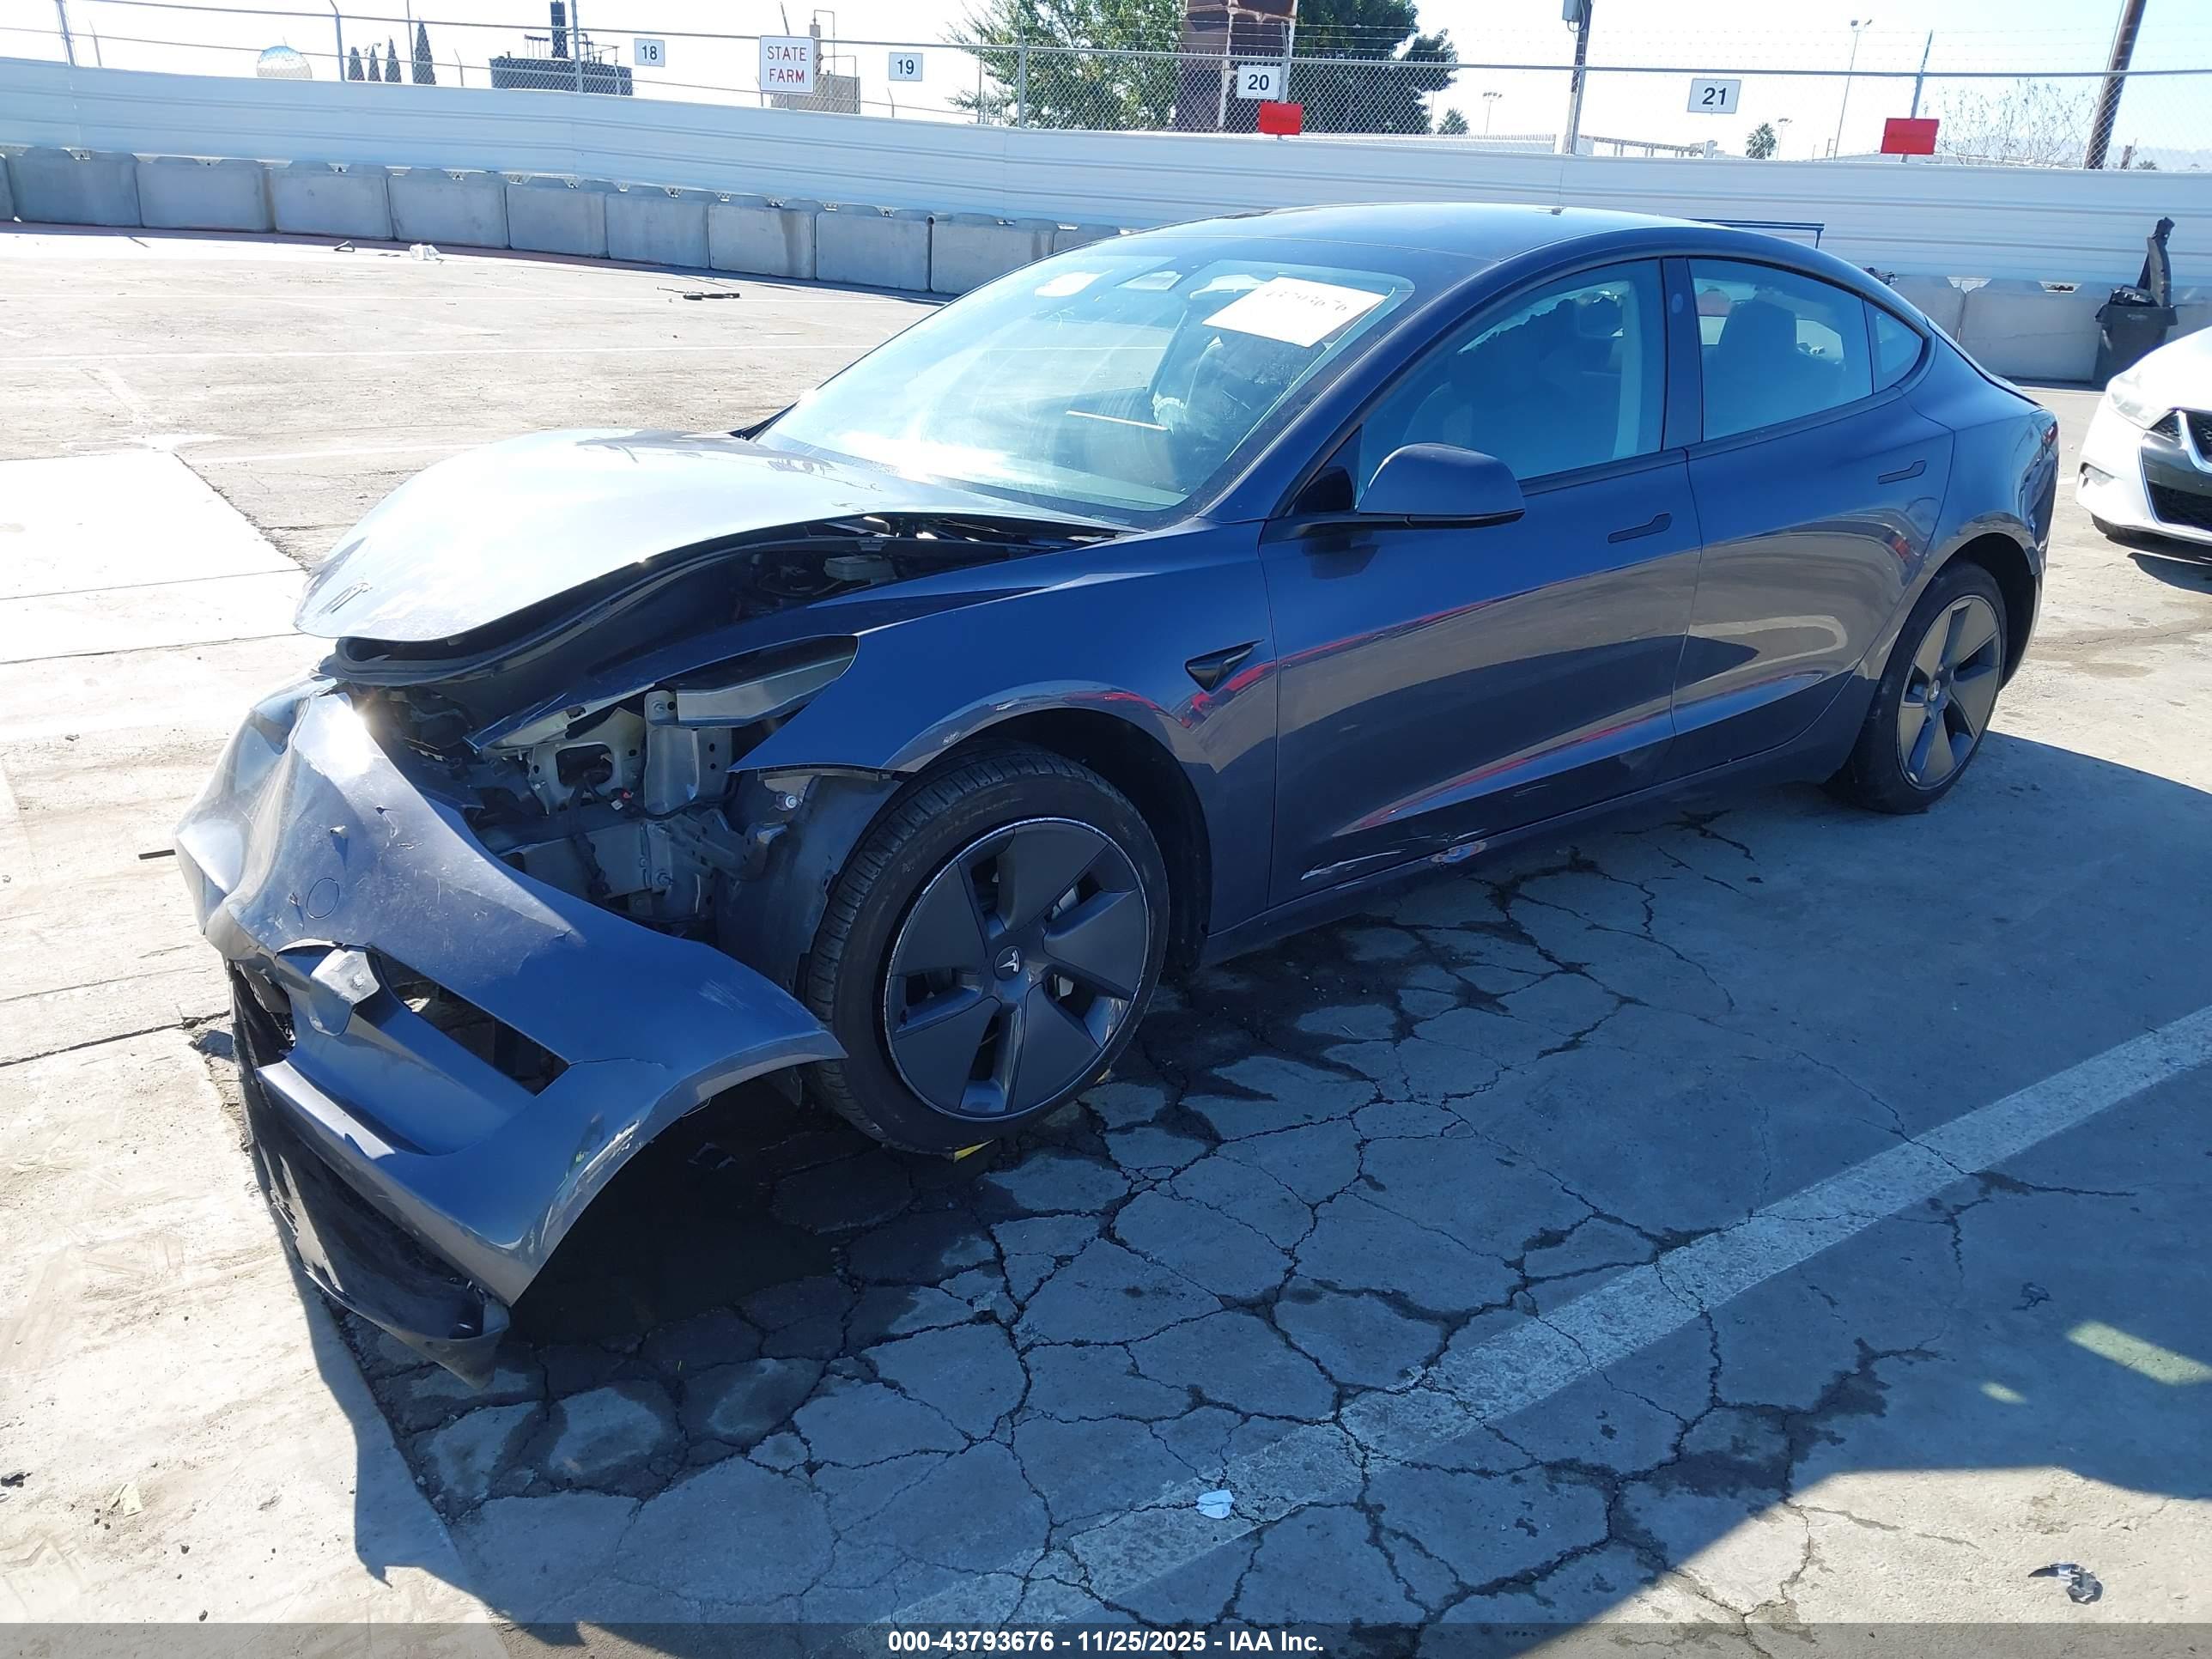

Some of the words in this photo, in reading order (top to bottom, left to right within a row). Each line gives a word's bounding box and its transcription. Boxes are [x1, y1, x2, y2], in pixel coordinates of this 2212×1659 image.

[641, 45, 658, 60] 18
[767, 46, 807, 62] STATE
[897, 59, 915, 75] 19
[769, 68, 805, 84] FARM
[1248, 74, 1270, 91] 20
[1702, 87, 1728, 106] 21
